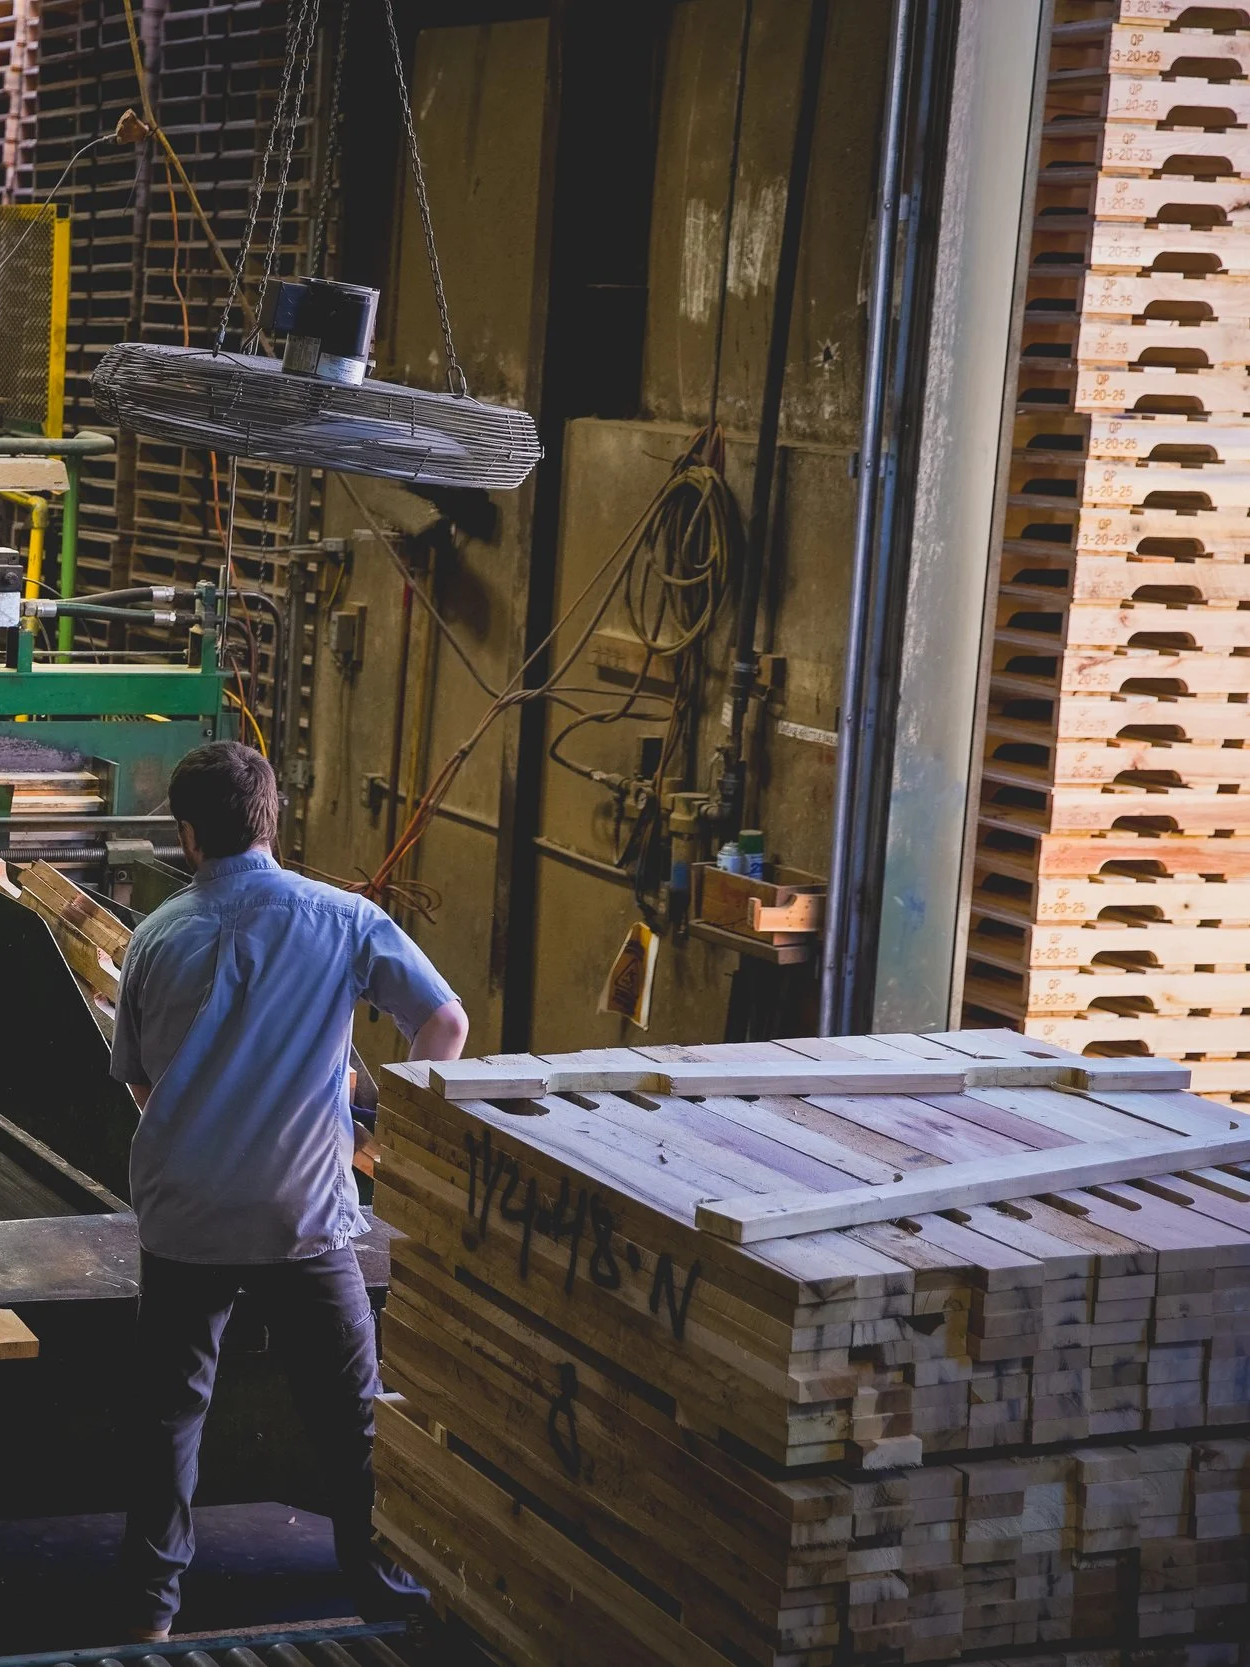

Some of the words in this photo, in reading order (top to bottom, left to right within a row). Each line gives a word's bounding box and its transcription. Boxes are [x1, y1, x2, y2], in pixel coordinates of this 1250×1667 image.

[1113, 50, 1161, 63] 3-20-25
[1106, 149, 1152, 162] 3-20-25
[1081, 389, 1126, 401] 3-20-25
[1092, 437, 1138, 450] 3-20-25
[1087, 484, 1133, 497] 3-20-25
[1083, 533, 1128, 545] 3-20-25
[1041, 901, 1086, 914] 3-20-25
[1035, 947, 1079, 960] 3-20-25
[1033, 993, 1077, 1005] 3-20-25
